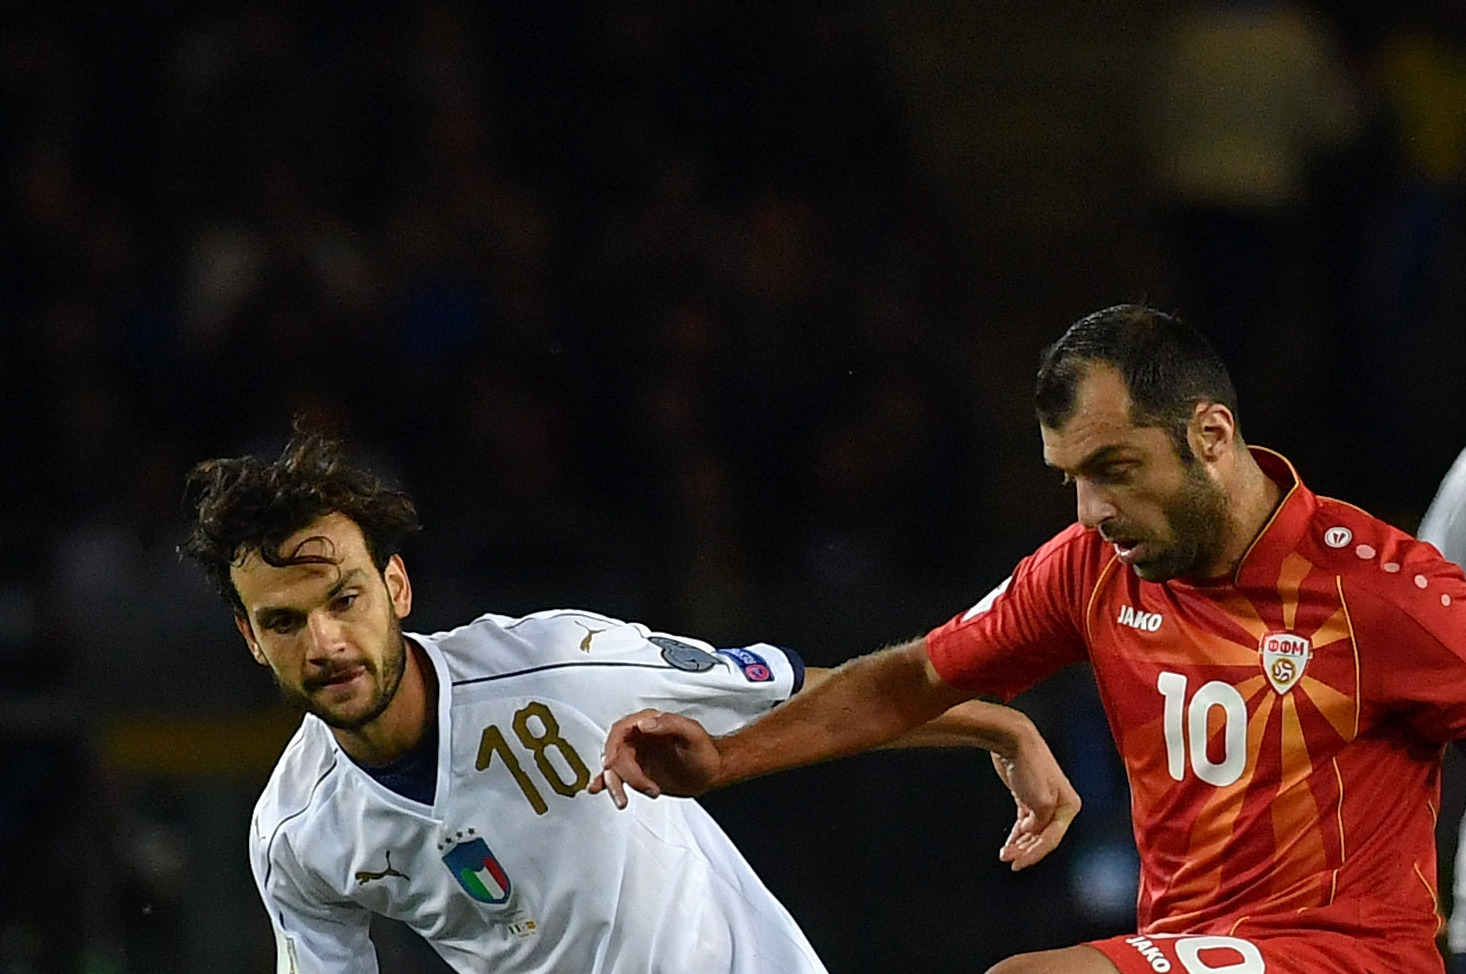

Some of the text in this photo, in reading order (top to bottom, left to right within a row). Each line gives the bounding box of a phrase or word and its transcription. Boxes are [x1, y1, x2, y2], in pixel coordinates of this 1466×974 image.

[1117, 605, 1163, 632] JAKO
[474, 701, 592, 816] 18
[1157, 671, 1248, 787] 10
[1125, 936, 1171, 974] JAKO
